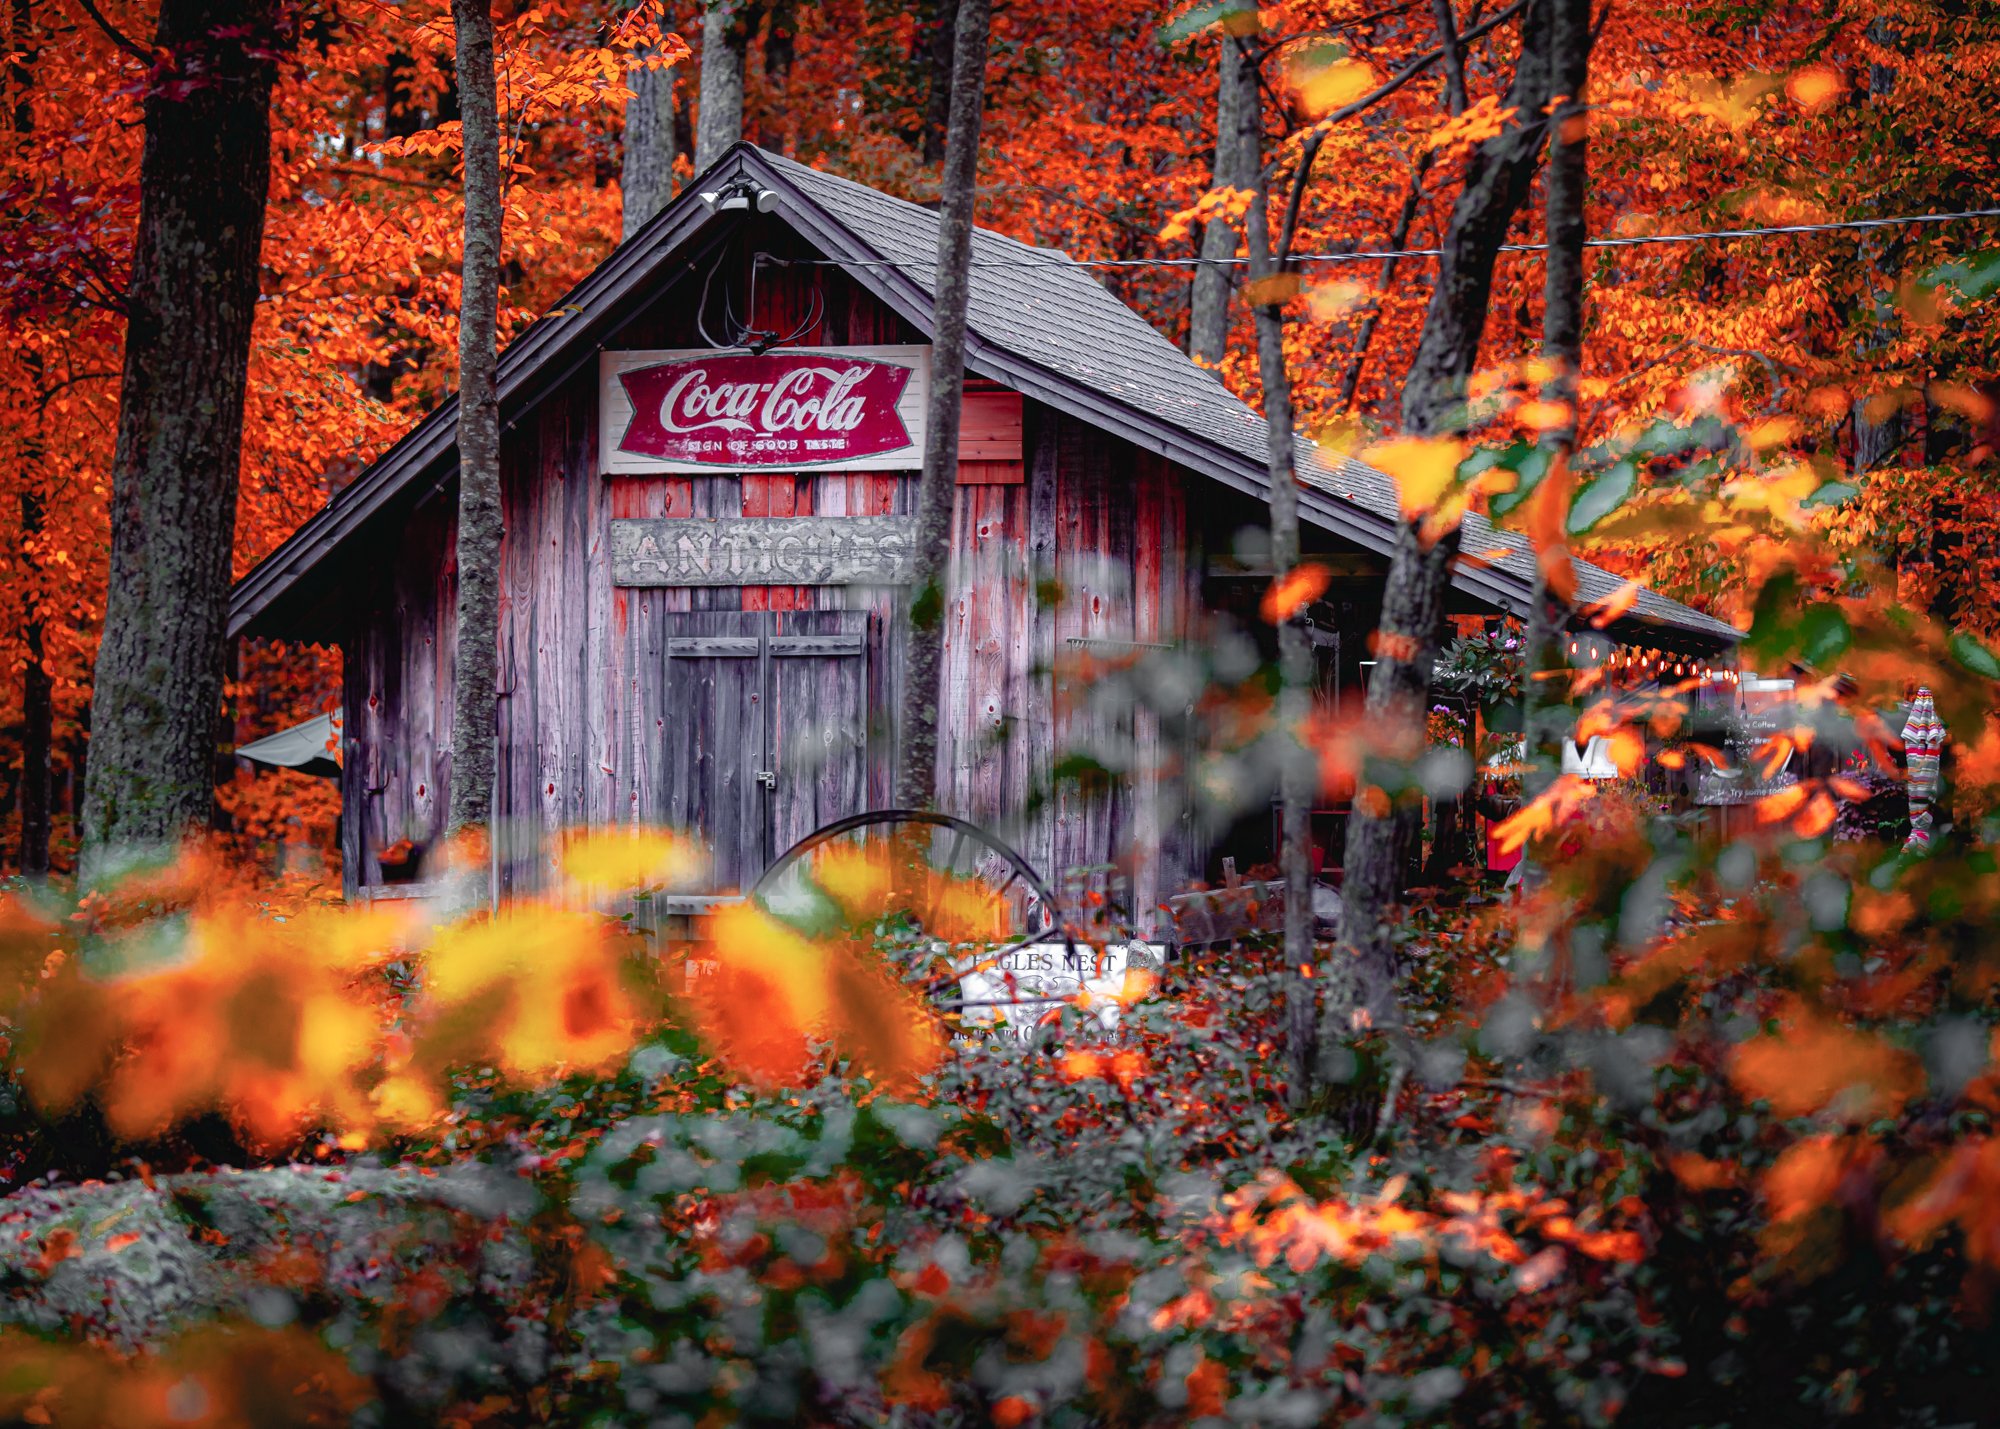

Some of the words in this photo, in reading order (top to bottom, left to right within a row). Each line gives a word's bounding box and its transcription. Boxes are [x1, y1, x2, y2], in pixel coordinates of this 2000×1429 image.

[660, 364, 875, 434] Coca-Cola
[688, 440, 722, 451] SIGN
[730, 440, 748, 451] OF
[755, 439, 798, 450] GOOD
[804, 439, 845, 449] TASTE
[631, 533, 905, 574] ANTIQUES
[1062, 954, 1117, 972] NEST
